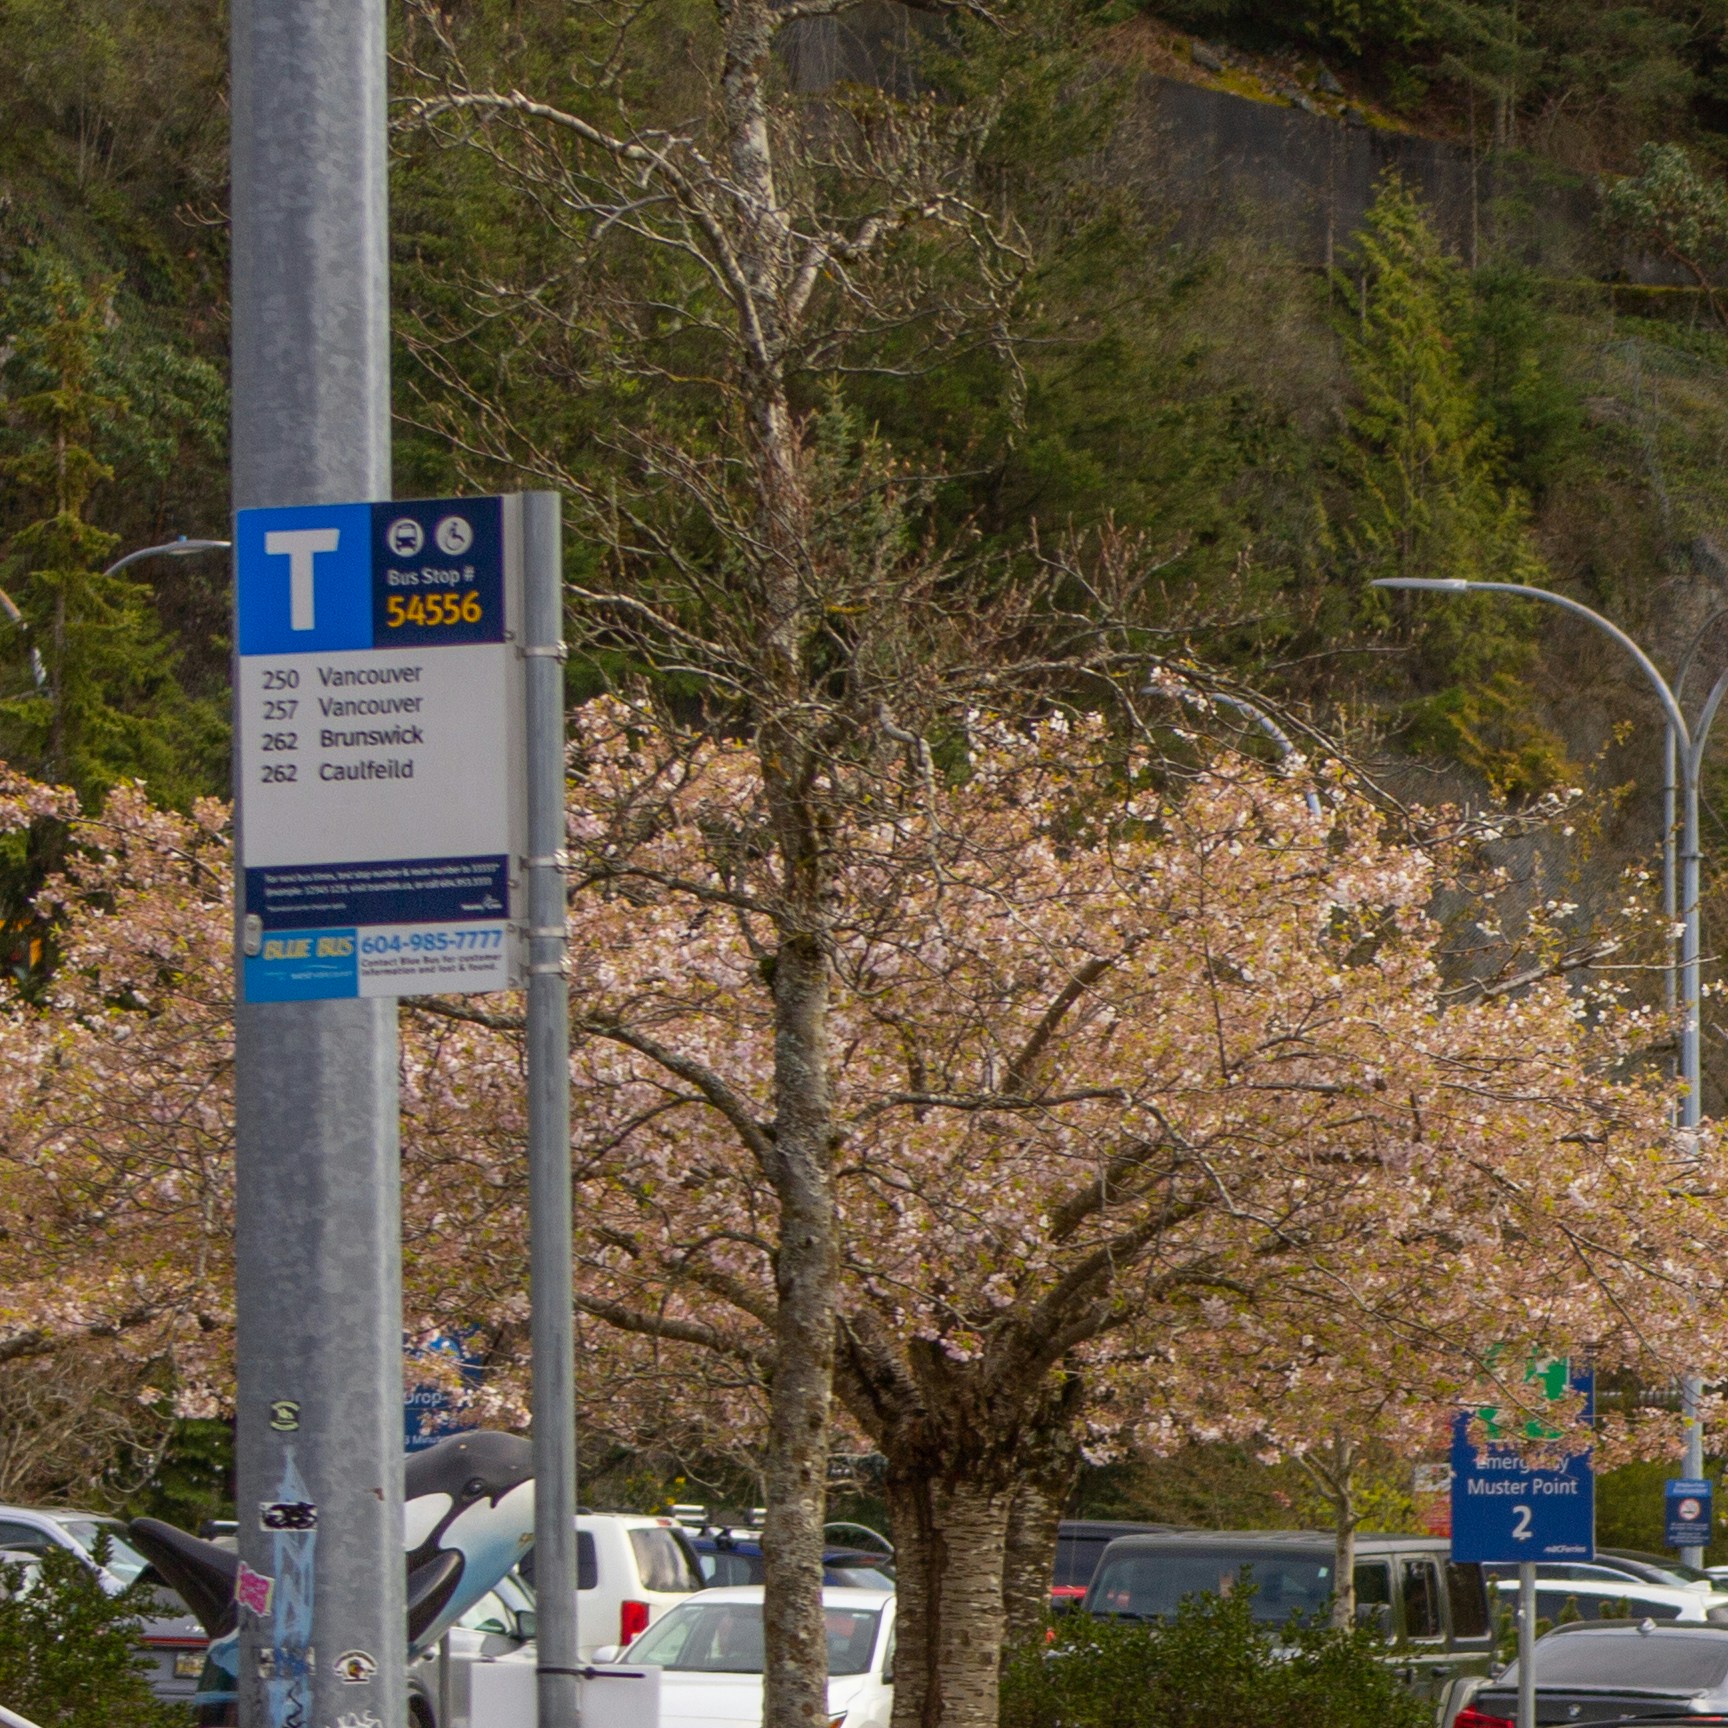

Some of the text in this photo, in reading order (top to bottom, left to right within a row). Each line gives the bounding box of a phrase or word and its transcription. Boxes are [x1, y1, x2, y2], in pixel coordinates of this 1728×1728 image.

[264, 527, 341, 632] T
[387, 565, 476, 588] Bus Stop #
[386, 590, 483, 628] 54556
[262, 665, 423, 690] 250 Vancouver
[263, 696, 423, 721] 257 Vancouver
[261, 725, 424, 751] 262 Brunswick
[260, 758, 414, 783] 262 Caulfeild
[361, 930, 503, 955] 604-985-7777
[361, 959, 397, 969] Contact
[400, 957, 420, 968] Blue
[1467, 1478, 1578, 1496] Muster Point
[1511, 1505, 1534, 1540] 2
